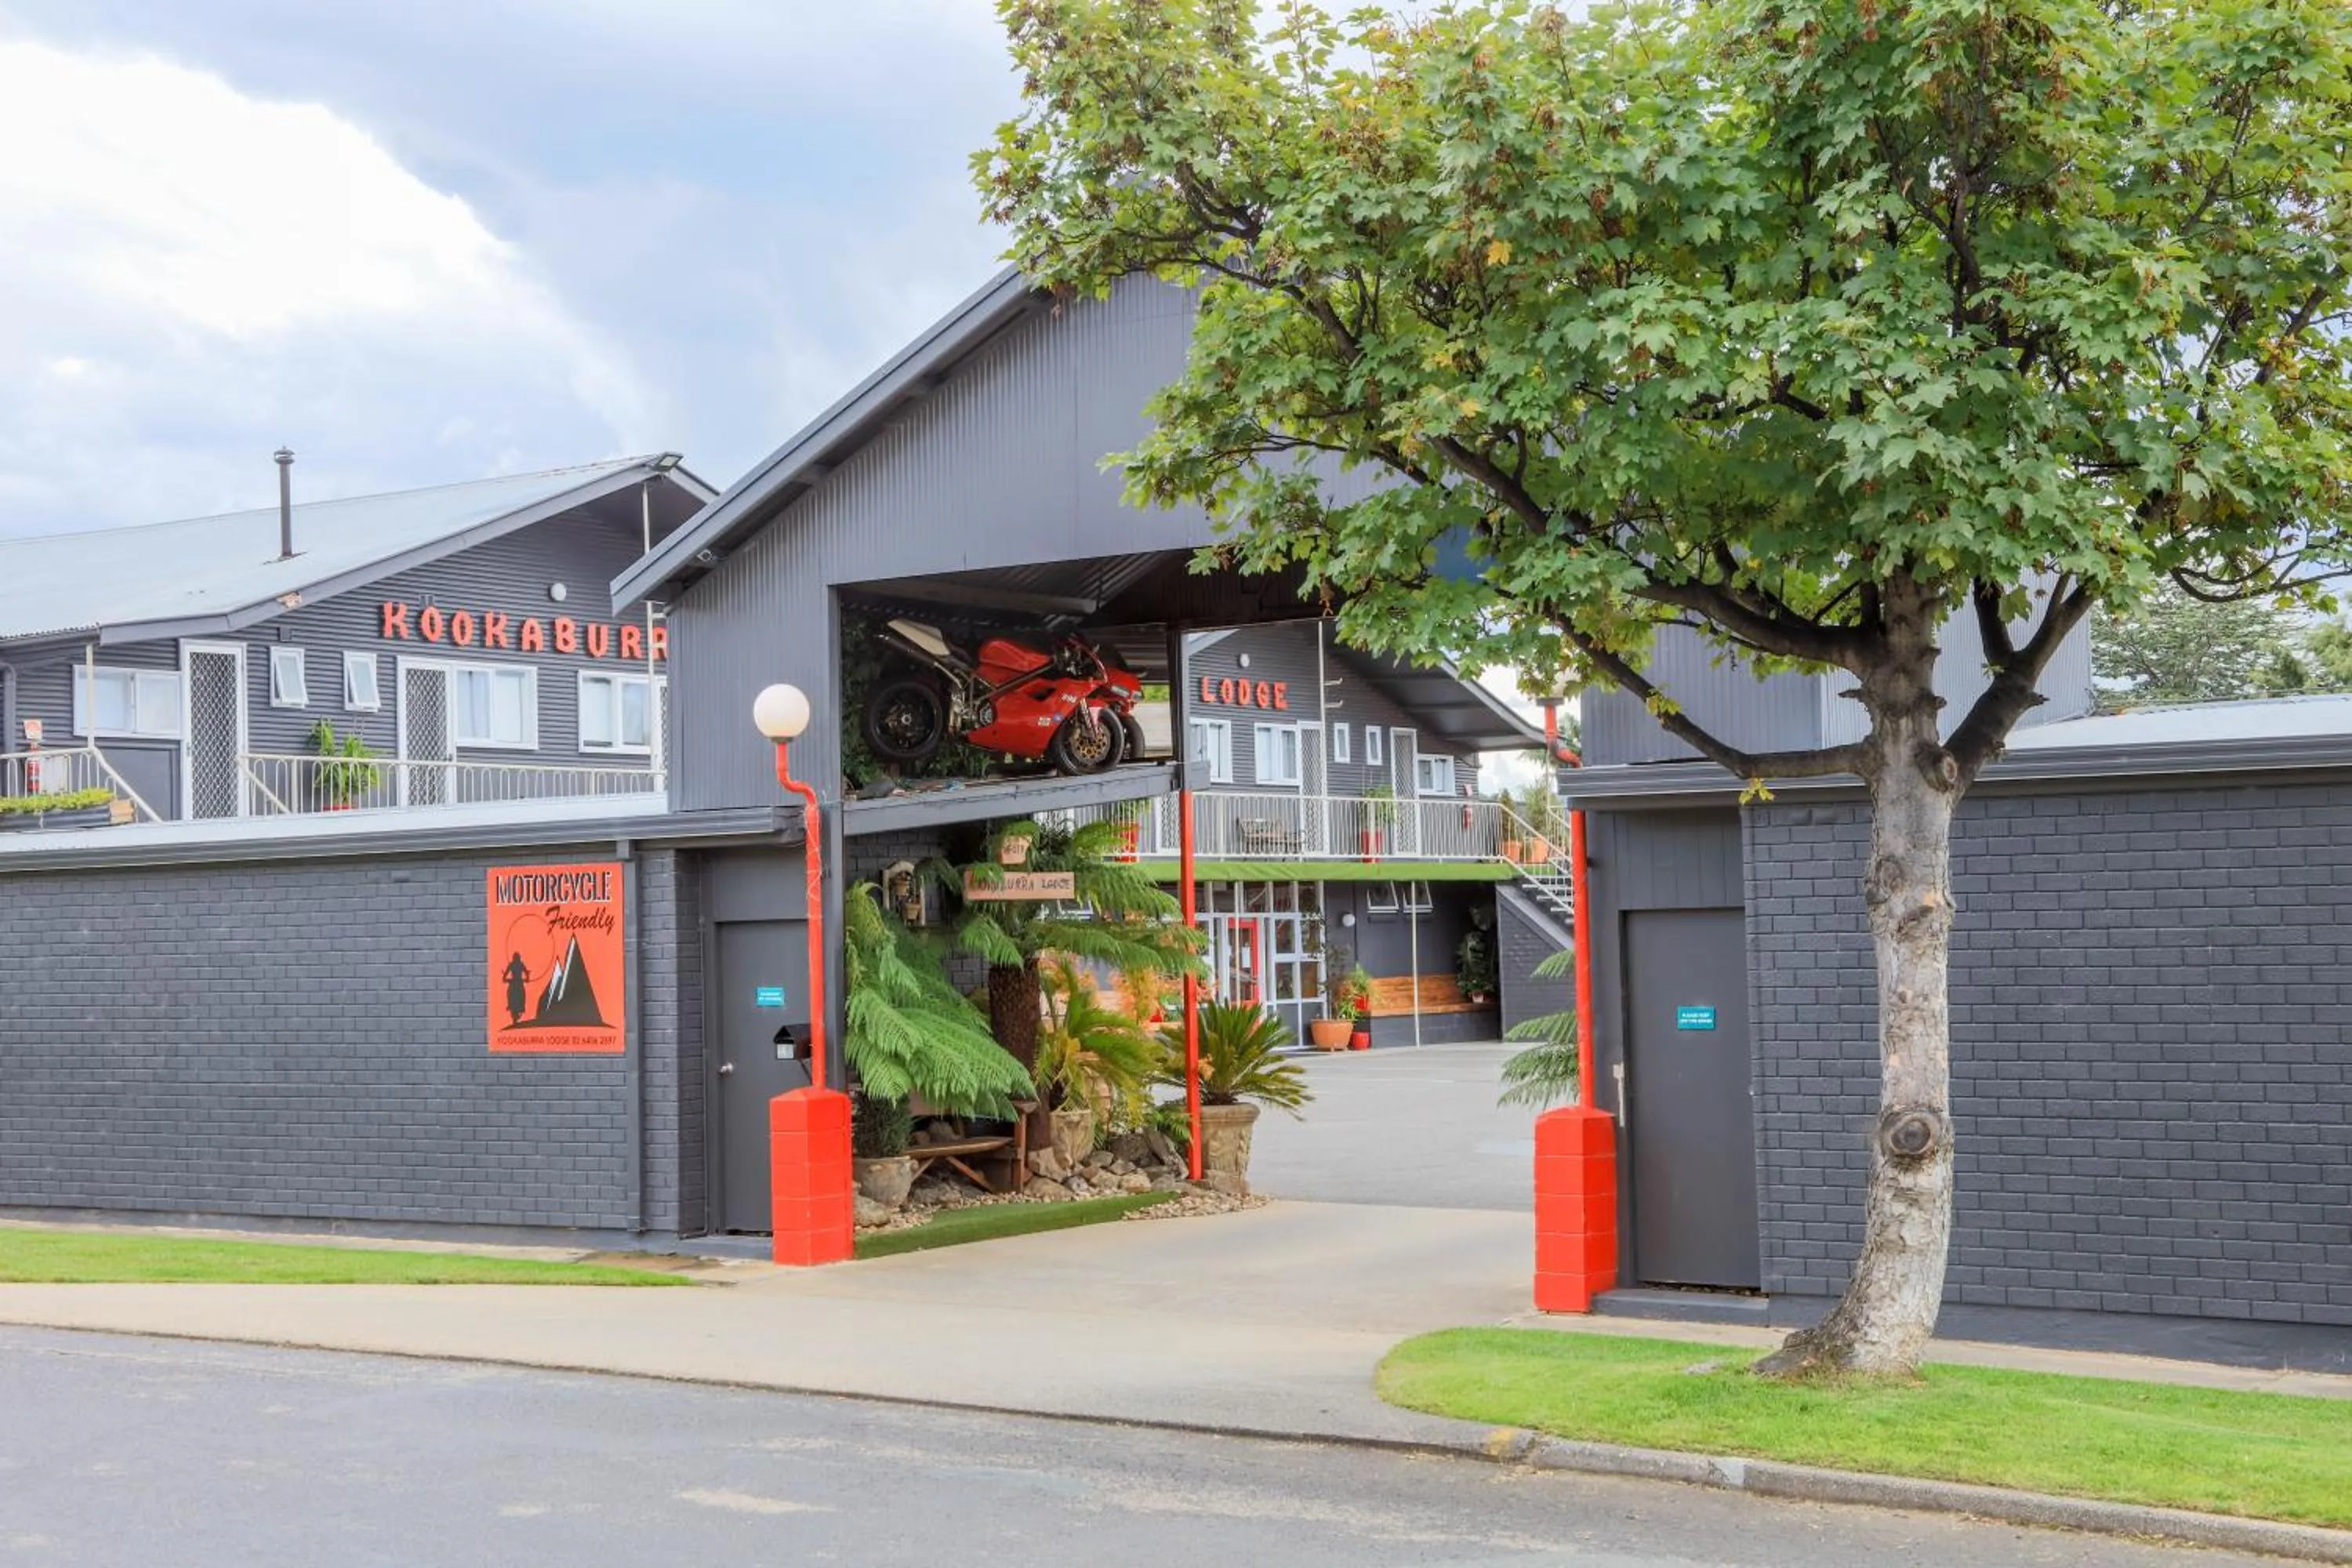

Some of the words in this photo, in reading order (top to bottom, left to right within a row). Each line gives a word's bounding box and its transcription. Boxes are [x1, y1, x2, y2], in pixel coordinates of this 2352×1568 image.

[1201, 675, 1290, 710] LODGE
[495, 870, 613, 905] MOTORCYCLE
[545, 906, 615, 936] Friendly
